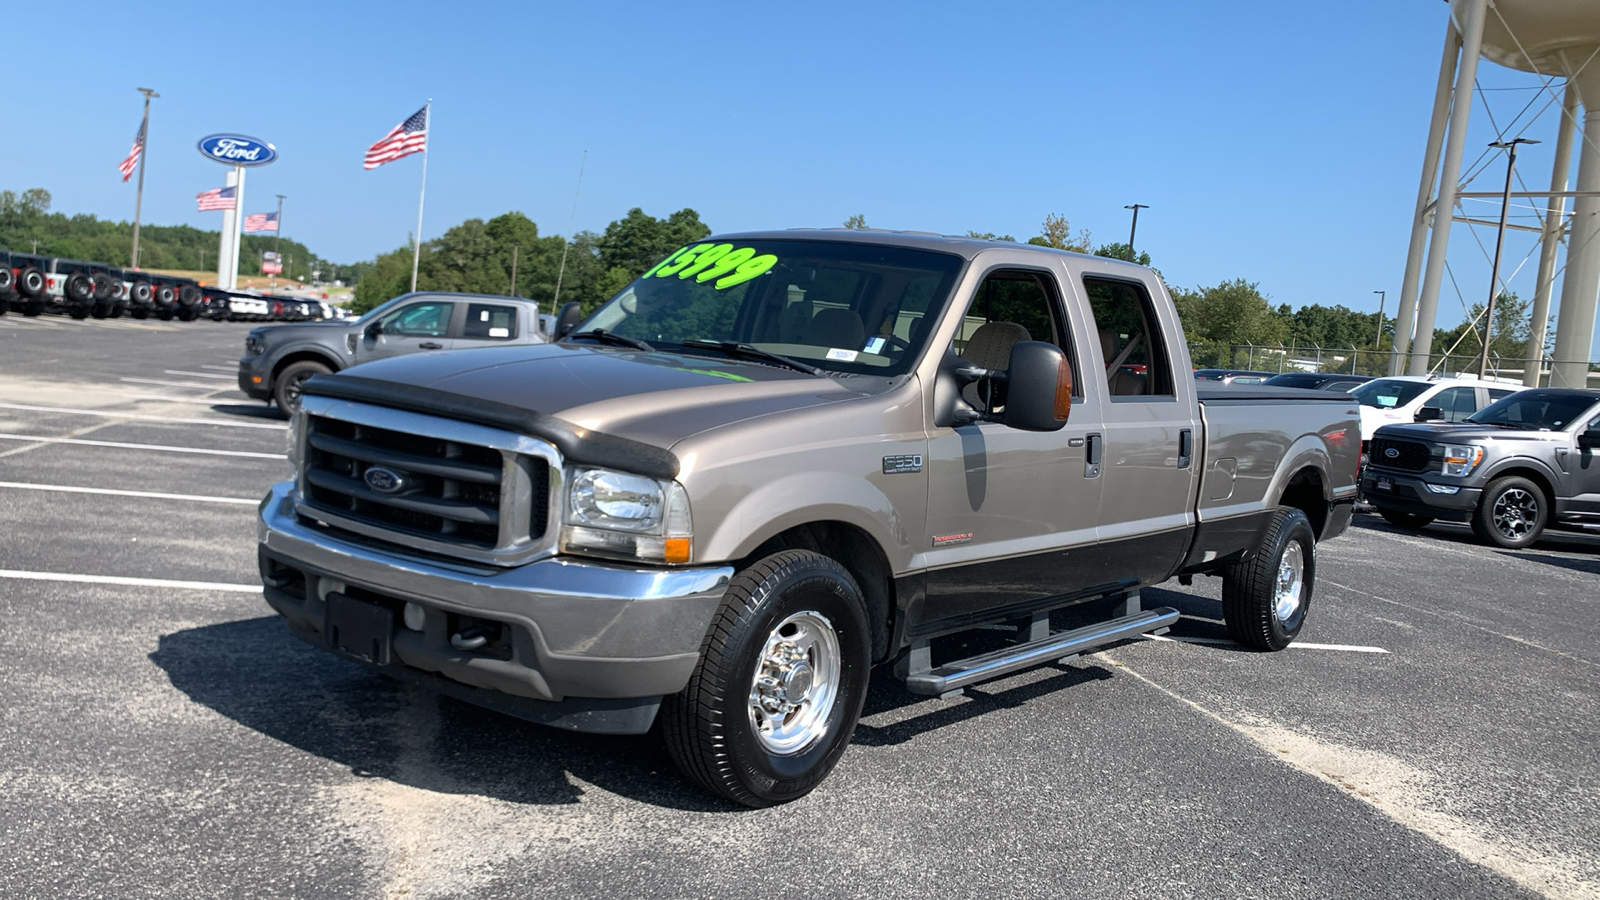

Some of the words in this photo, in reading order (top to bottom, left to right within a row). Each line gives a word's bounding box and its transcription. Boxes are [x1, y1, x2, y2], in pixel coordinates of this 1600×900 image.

[212, 138, 261, 160] Ford
[641, 243, 778, 290] 15999
[371, 471, 393, 488] Ford
